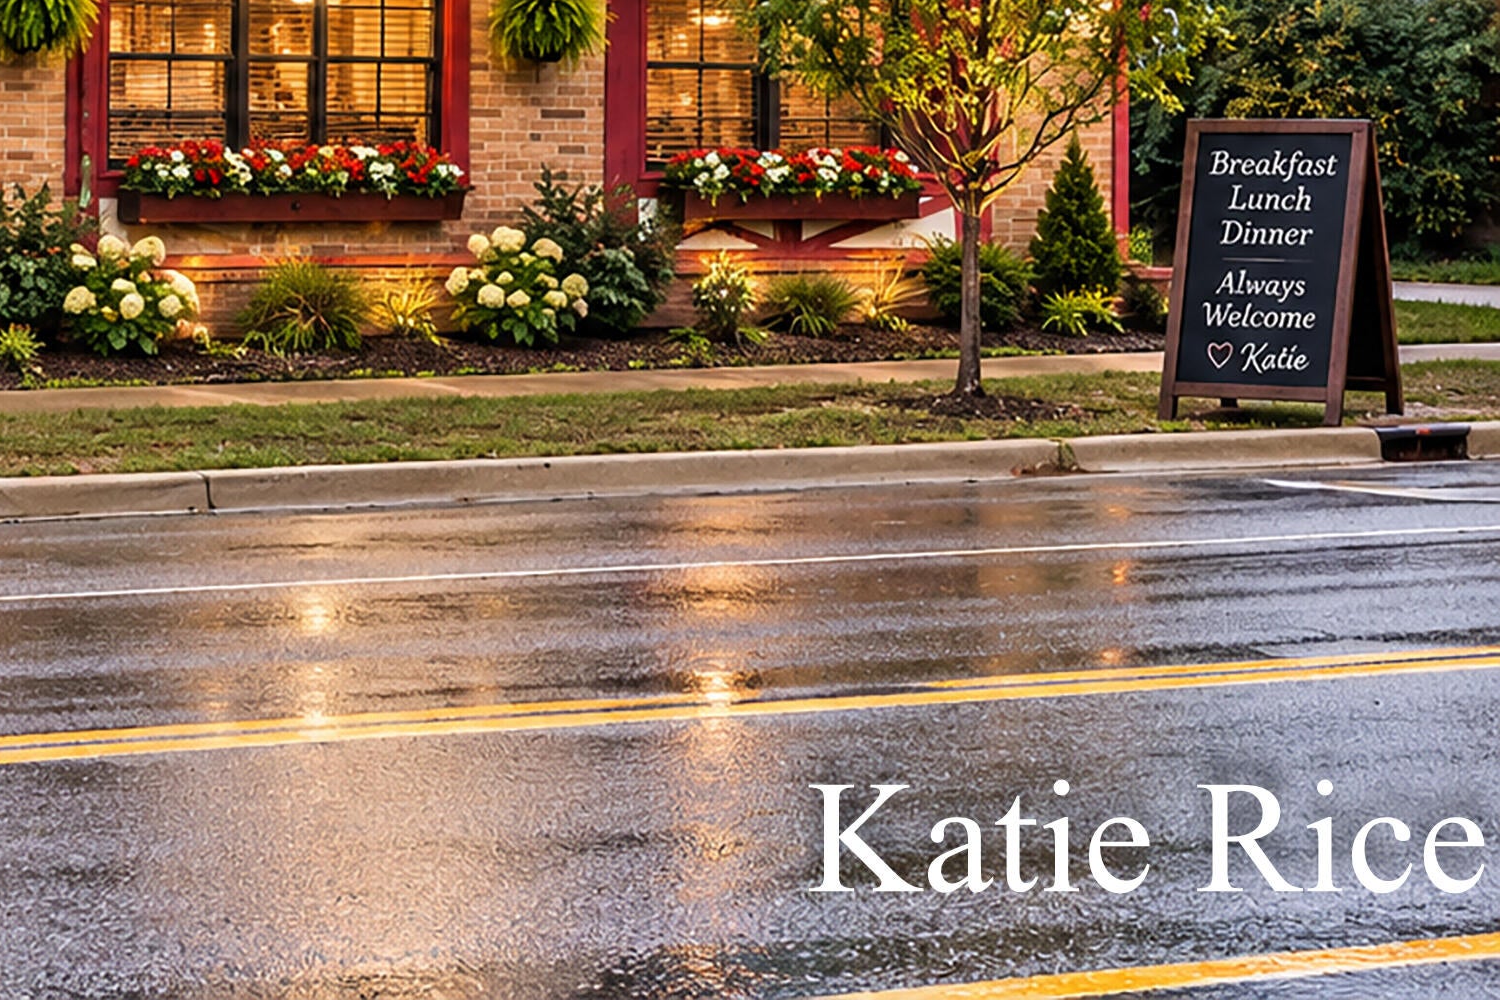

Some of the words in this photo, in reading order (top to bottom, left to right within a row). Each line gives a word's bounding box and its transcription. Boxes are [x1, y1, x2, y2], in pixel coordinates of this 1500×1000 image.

[1209, 150, 1338, 182] Breakfast
[1228, 185, 1311, 211] Lunch
[1220, 220, 1313, 246] Dinner
[1215, 270, 1306, 302] Always
[1202, 302, 1316, 329] Welcome
[1241, 342, 1309, 374] Katie
